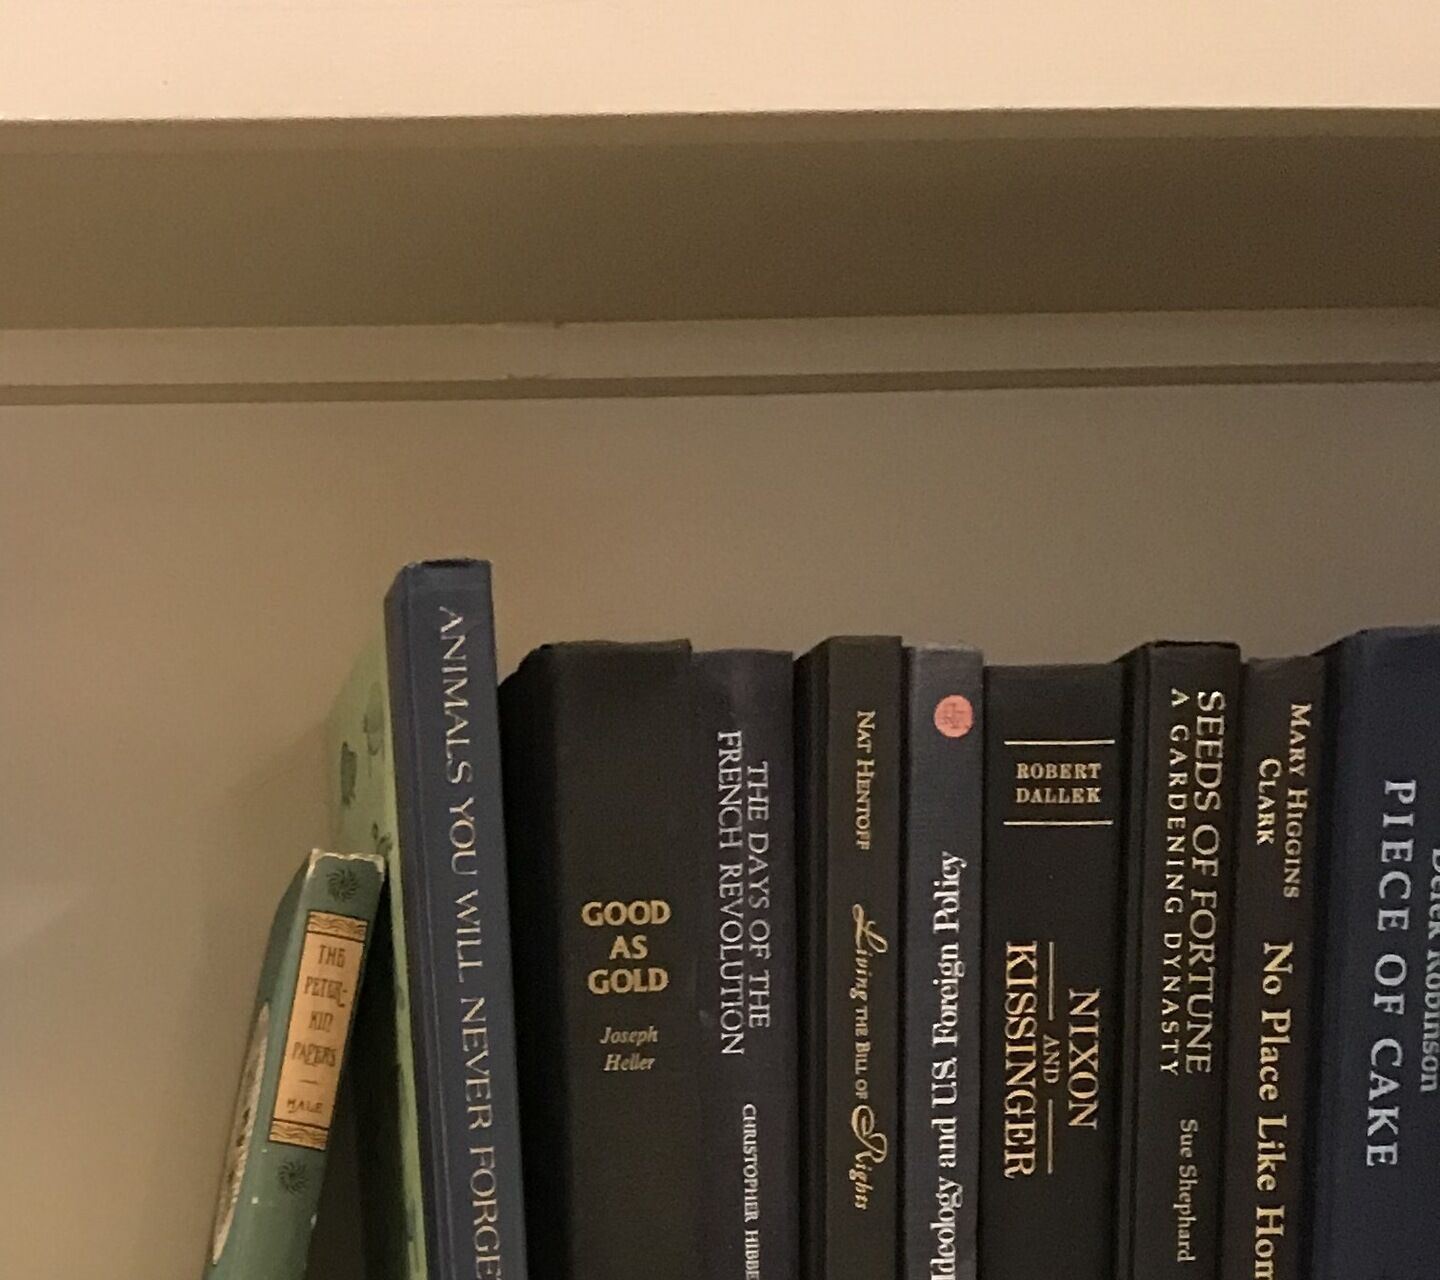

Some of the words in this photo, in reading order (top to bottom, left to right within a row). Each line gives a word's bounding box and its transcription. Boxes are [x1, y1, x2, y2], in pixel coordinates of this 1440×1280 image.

[438, 606, 472, 784] ANIMALS
[855, 710, 876, 753] NAT
[1170, 687, 1191, 707] A
[1016, 763, 1101, 780] ROBERT
[1191, 691, 1226, 811] SEEDS
[1288, 702, 1312, 777] MARY
[716, 730, 744, 849] FRENCH
[747, 761, 769, 822] THE
[854, 759, 875, 850] HENTOFF
[1016, 787, 1102, 804] DALLEK
[1162, 724, 1190, 914] GARDENING
[1256, 758, 1283, 847] CLARK
[447, 797, 478, 876] YOU
[747, 832, 770, 909] DAYS
[1190, 824, 1220, 877] OF
[1281, 787, 1310, 899] HIGGINS
[1376, 779, 1418, 932] PIECE
[453, 889, 483, 982] WILL
[581, 900, 671, 927] GOOD
[609, 935, 649, 959] AS
[747, 919, 772, 959] OF
[587, 967, 670, 995] GOLD
[718, 864, 745, 1056] REVOLUTION
[747, 969, 772, 1029] THE
[1184, 888, 1217, 1074] FORTUNE
[1262, 941, 1295, 997] No
[1371, 953, 1408, 1015] OF
[599, 1026, 659, 1045] Joseph
[1159, 932, 1184, 1076] DYNASTY
[461, 996, 494, 1130] NEVER
[601, 1053, 656, 1072] Heller
[1004, 941, 1039, 1180] KISSINGER
[1041, 1034, 1060, 1083] AND
[1069, 987, 1101, 1130] NIXON
[1259, 1008, 1292, 1102] Place
[1364, 1038, 1402, 1168] CAKE
[741, 1103, 759, 1223] CHRISTOPHER
[1256, 1114, 1289, 1192] Like
